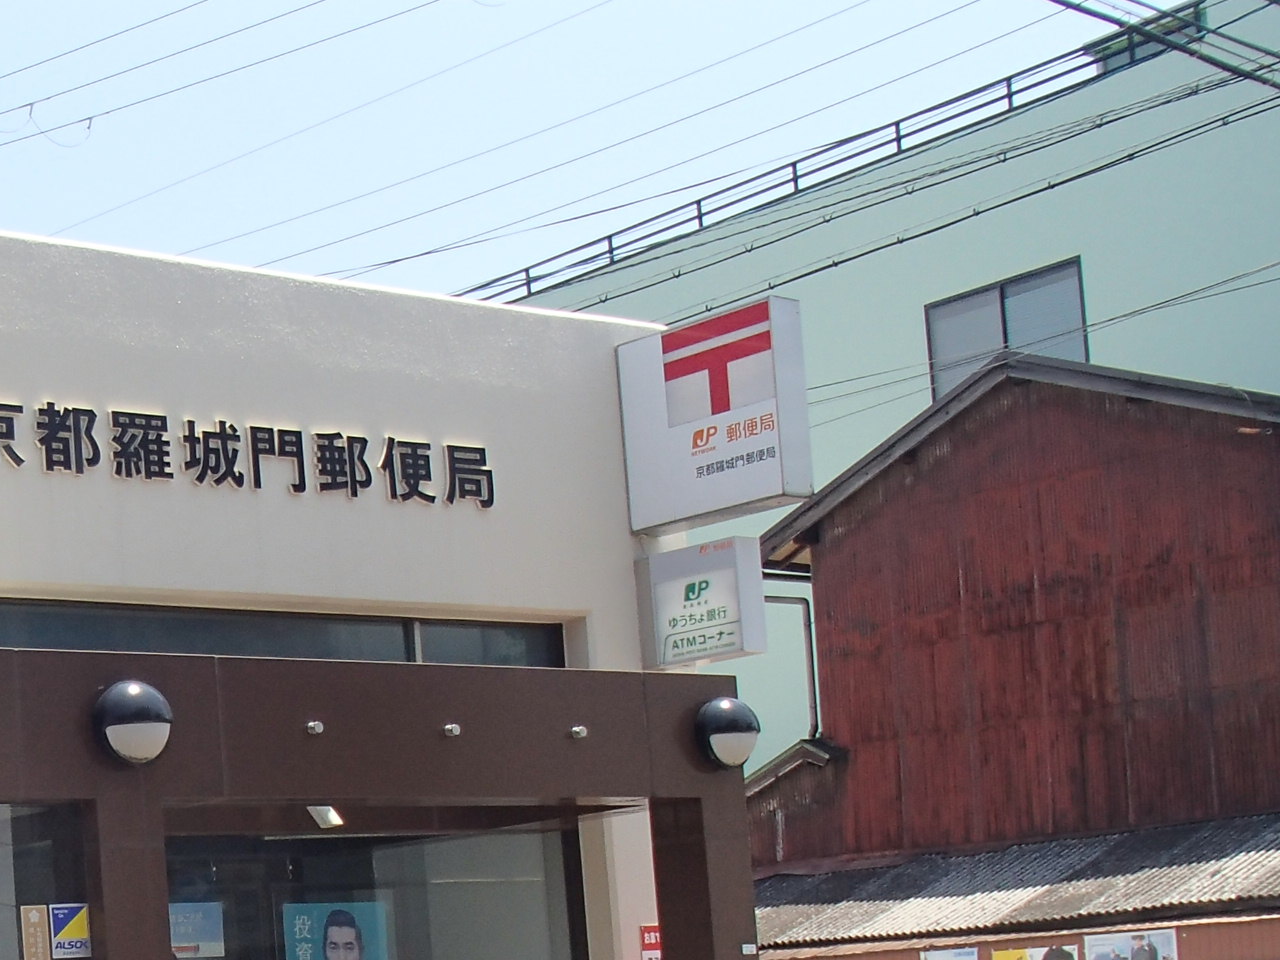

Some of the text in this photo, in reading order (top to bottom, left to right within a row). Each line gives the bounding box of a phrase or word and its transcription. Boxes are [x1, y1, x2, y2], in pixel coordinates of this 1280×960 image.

[726, 413, 775, 443] 郵便局
[695, 446, 776, 478] 京都羅城門郵便局
[668, 606, 727, 629] ゆうちょ銀行
[672, 631, 735, 651] ATMコーナー
[55, 940, 89, 950] ALSOK
